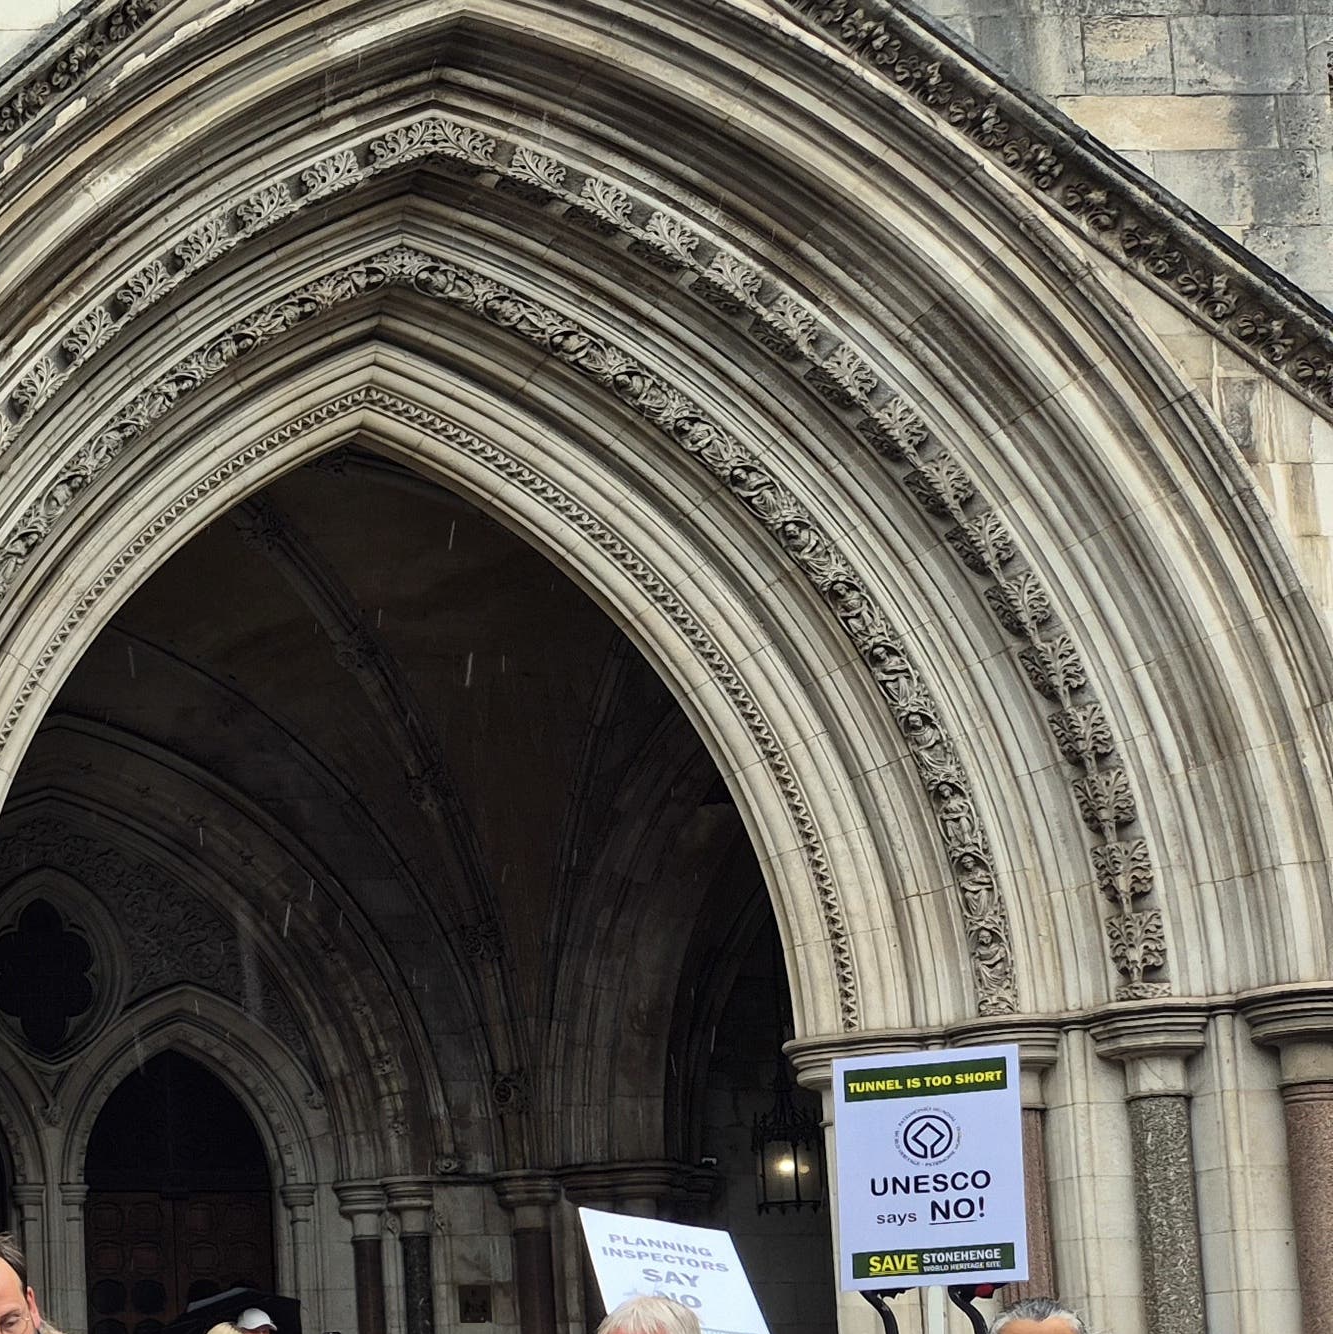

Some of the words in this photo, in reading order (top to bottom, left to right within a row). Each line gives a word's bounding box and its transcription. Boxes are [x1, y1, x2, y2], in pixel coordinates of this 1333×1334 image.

[848, 1079, 903, 1093] TUNNEL
[906, 1077, 921, 1089] IS
[924, 1075, 952, 1087] TOO
[955, 1070, 1003, 1084] SHORT
[870, 1169, 991, 1197] UNESCO
[876, 1211, 917, 1227] says
[930, 1196, 985, 1222] NO!
[609, 1234, 712, 1257] PLANNING
[602, 1247, 729, 1272] INSPECTORS
[869, 1254, 919, 1274] SAVE
[922, 1248, 1002, 1264] STONEHENGE
[642, 1268, 699, 1288] SAY
